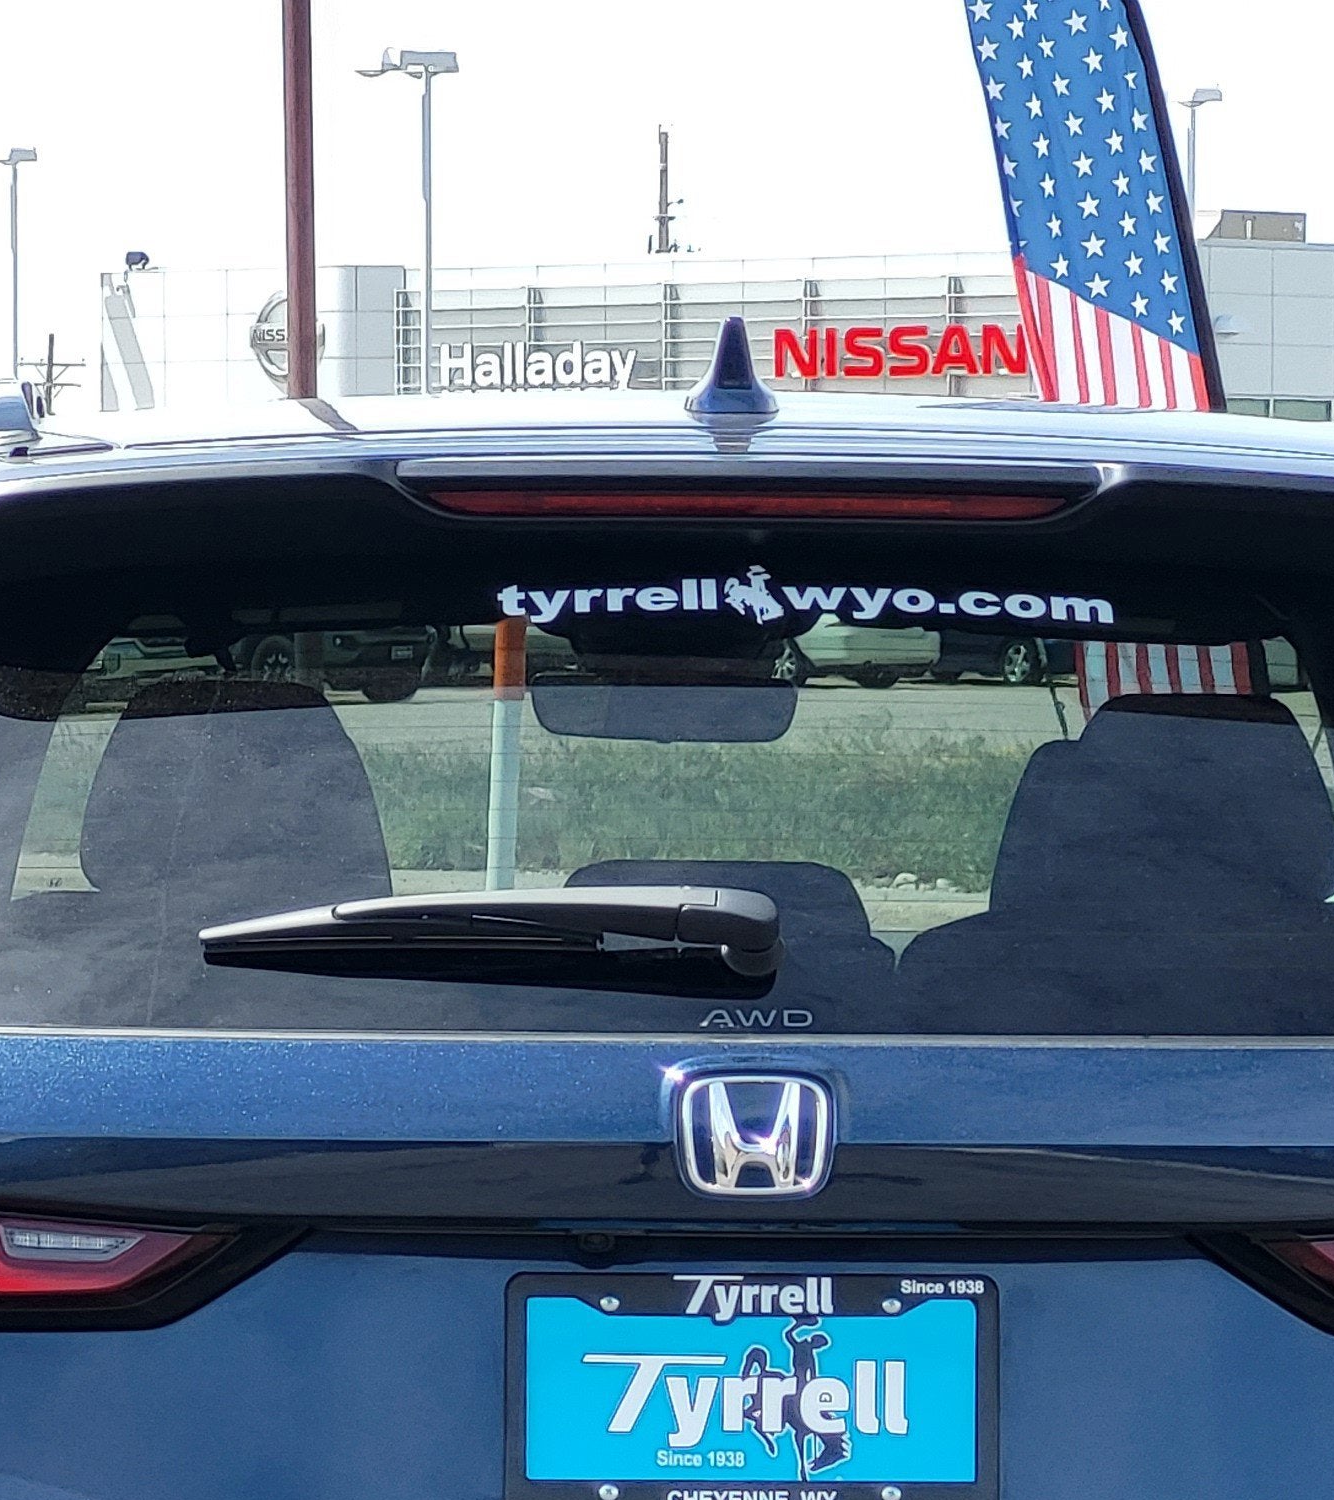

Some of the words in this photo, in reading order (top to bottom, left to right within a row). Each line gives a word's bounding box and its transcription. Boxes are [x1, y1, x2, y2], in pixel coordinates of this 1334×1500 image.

[253, 329, 288, 342] NISS
[774, 323, 1029, 378] NISSAN
[440, 340, 637, 391] Halladay
[498, 578, 717, 623] tyrrell
[782, 585, 1114, 624] wyo.com
[699, 1009, 813, 1028] AWD
[673, 1274, 834, 1321] Tyrrell
[900, 1279, 944, 1294] Since
[948, 1280, 985, 1294] 1938
[582, 1353, 909, 1447] Tyrrell
[656, 1450, 703, 1468] Since
[706, 1450, 745, 1468] 1938
